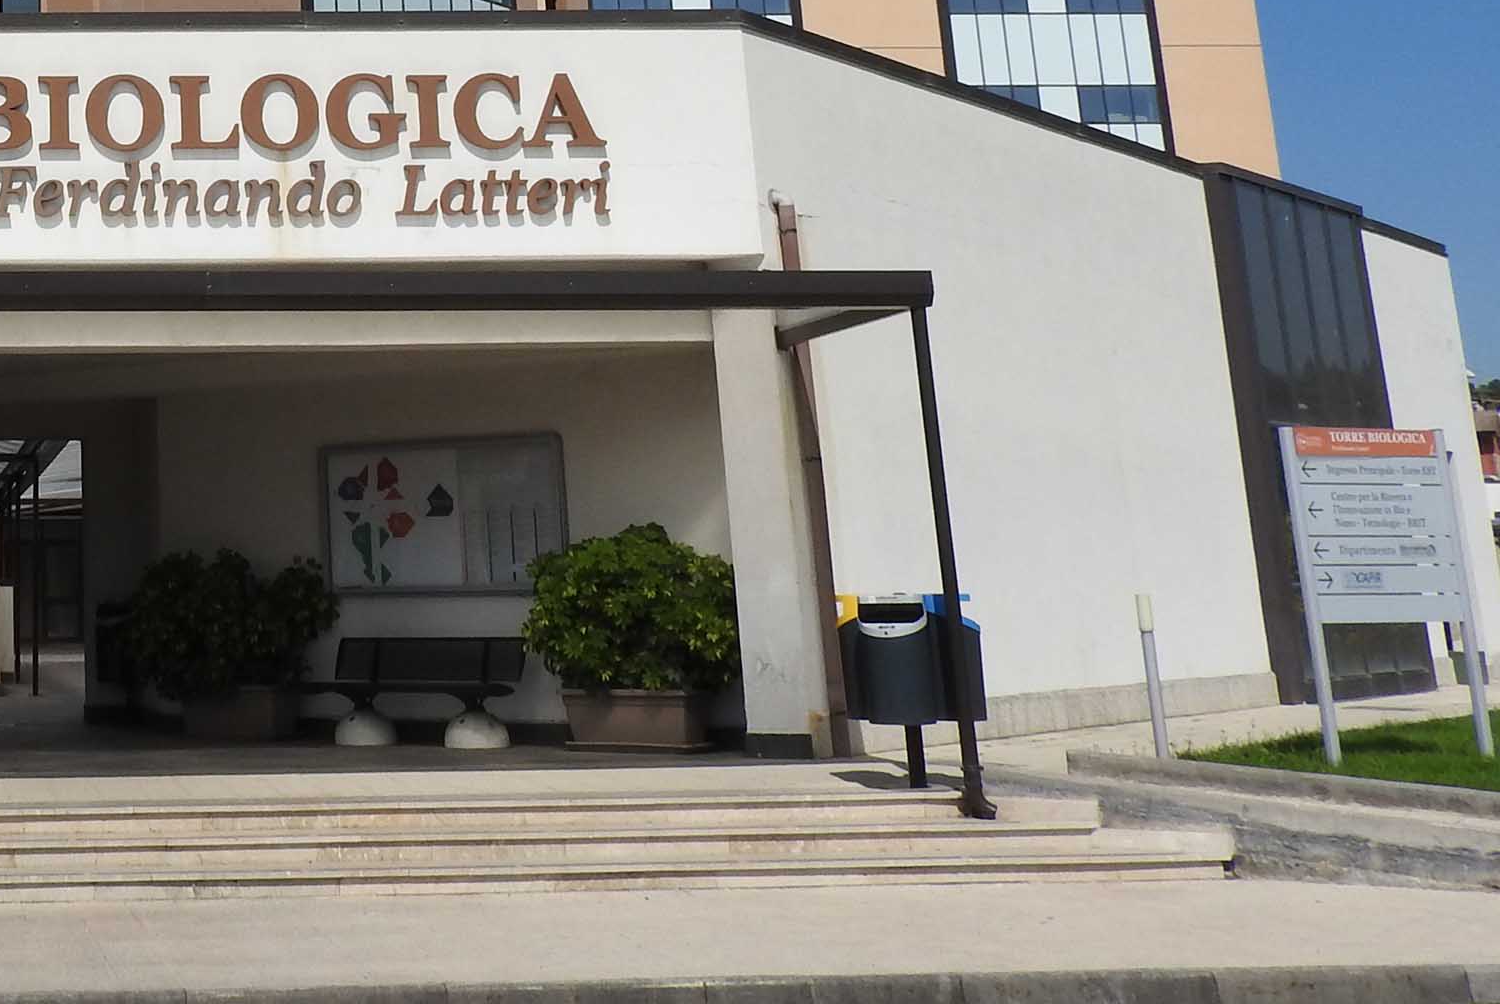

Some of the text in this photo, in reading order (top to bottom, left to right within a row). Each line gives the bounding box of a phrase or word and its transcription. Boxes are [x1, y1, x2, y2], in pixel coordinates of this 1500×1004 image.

[396, 160, 613, 220] Latteri
[1329, 431, 1366, 443] TORRE
[1368, 432, 1427, 444] BIOLOGICA
